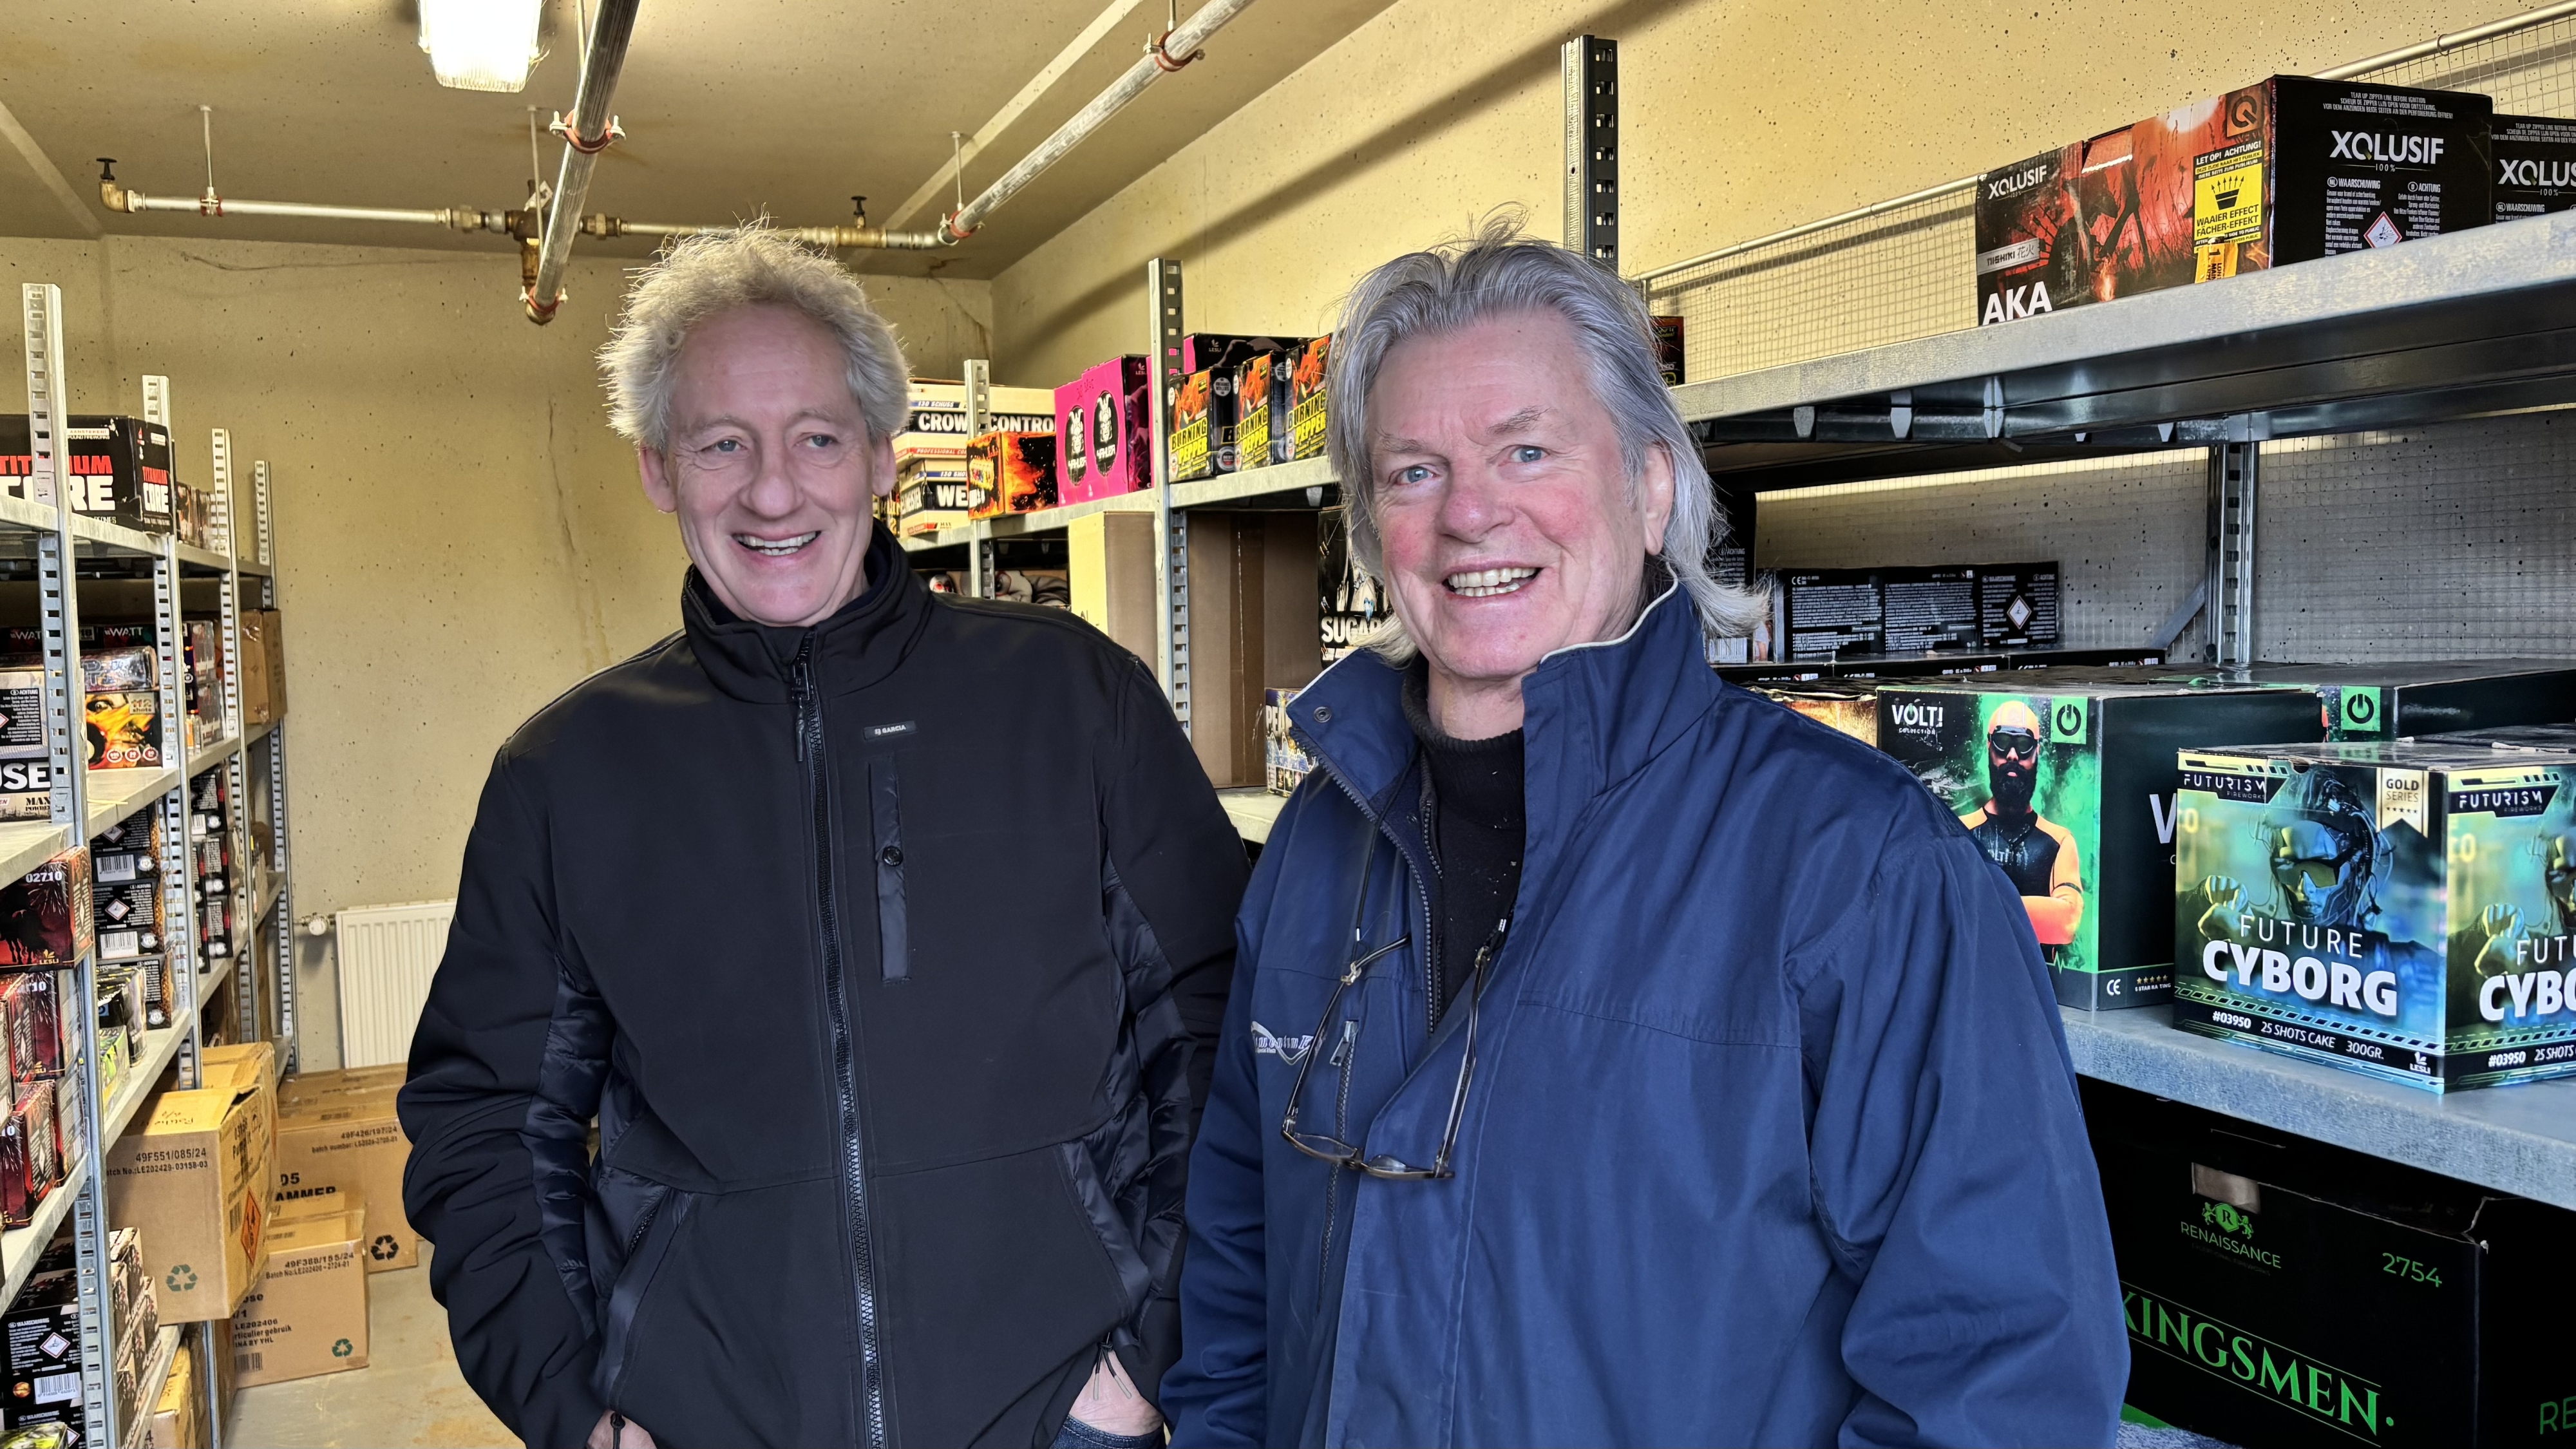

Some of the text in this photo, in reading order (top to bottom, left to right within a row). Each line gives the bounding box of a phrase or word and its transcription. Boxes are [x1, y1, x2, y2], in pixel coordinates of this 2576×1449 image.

[2196, 140, 2261, 166] LET OP! ACHTUNG!
[2376, 163, 2396, 172] 100%
[2338, 178, 2381, 189] WAARSCHUWING
[2418, 183, 2441, 193] ACHTUNG
[2197, 204, 2259, 227] WAAIER EFFECT
[2197, 214, 2259, 237] FÄCHER-EFFEKT
[1987, 251, 2015, 266] NISHIKI
[1982, 281, 2052, 326] AKA
[1288, 390, 1327, 432] BURNING
[990, 415, 1056, 432] CONTRO
[1236, 404, 1269, 443] BURNING
[1296, 412, 1327, 444] PEPPER
[1171, 417, 1208, 451] BURNING
[1242, 426, 1269, 456] PEPPER
[1179, 437, 1208, 464] PEPPER
[0, 455, 113, 475] TITIUM
[142, 466, 167, 484] TITANIUM
[142, 482, 169, 513] CORE
[131, 698, 152, 707] 112
[1892, 703, 1944, 727] VOLT!
[882, 724, 906, 734] GARCIA
[2183, 773, 2267, 793] FUTURISM
[2385, 778, 2420, 791] GOLD
[2226, 791, 2266, 801] FIREWORKS
[2385, 791, 2419, 803] SERIES
[2459, 790, 2543, 810] FUTURISM
[26, 871, 62, 884] 02710
[2240, 914, 2363, 960] FUTURE
[2107, 978, 2121, 996] CE
[2202, 939, 2398, 1017] CYBORG
[2212, 1010, 2384, 1060] #03950 25 SHOTS CAKE 300GR.
[2488, 1044, 2575, 1068] #03950 25 SHOTS
[2410, 1063, 2430, 1075] LESLI
[136, 1148, 207, 1163] 49F551/085/24
[2181, 1221, 2282, 1269] RENAISSANCE
[2383, 1253, 2443, 1287] 2754
[265, 1325, 292, 1336] gebruik
